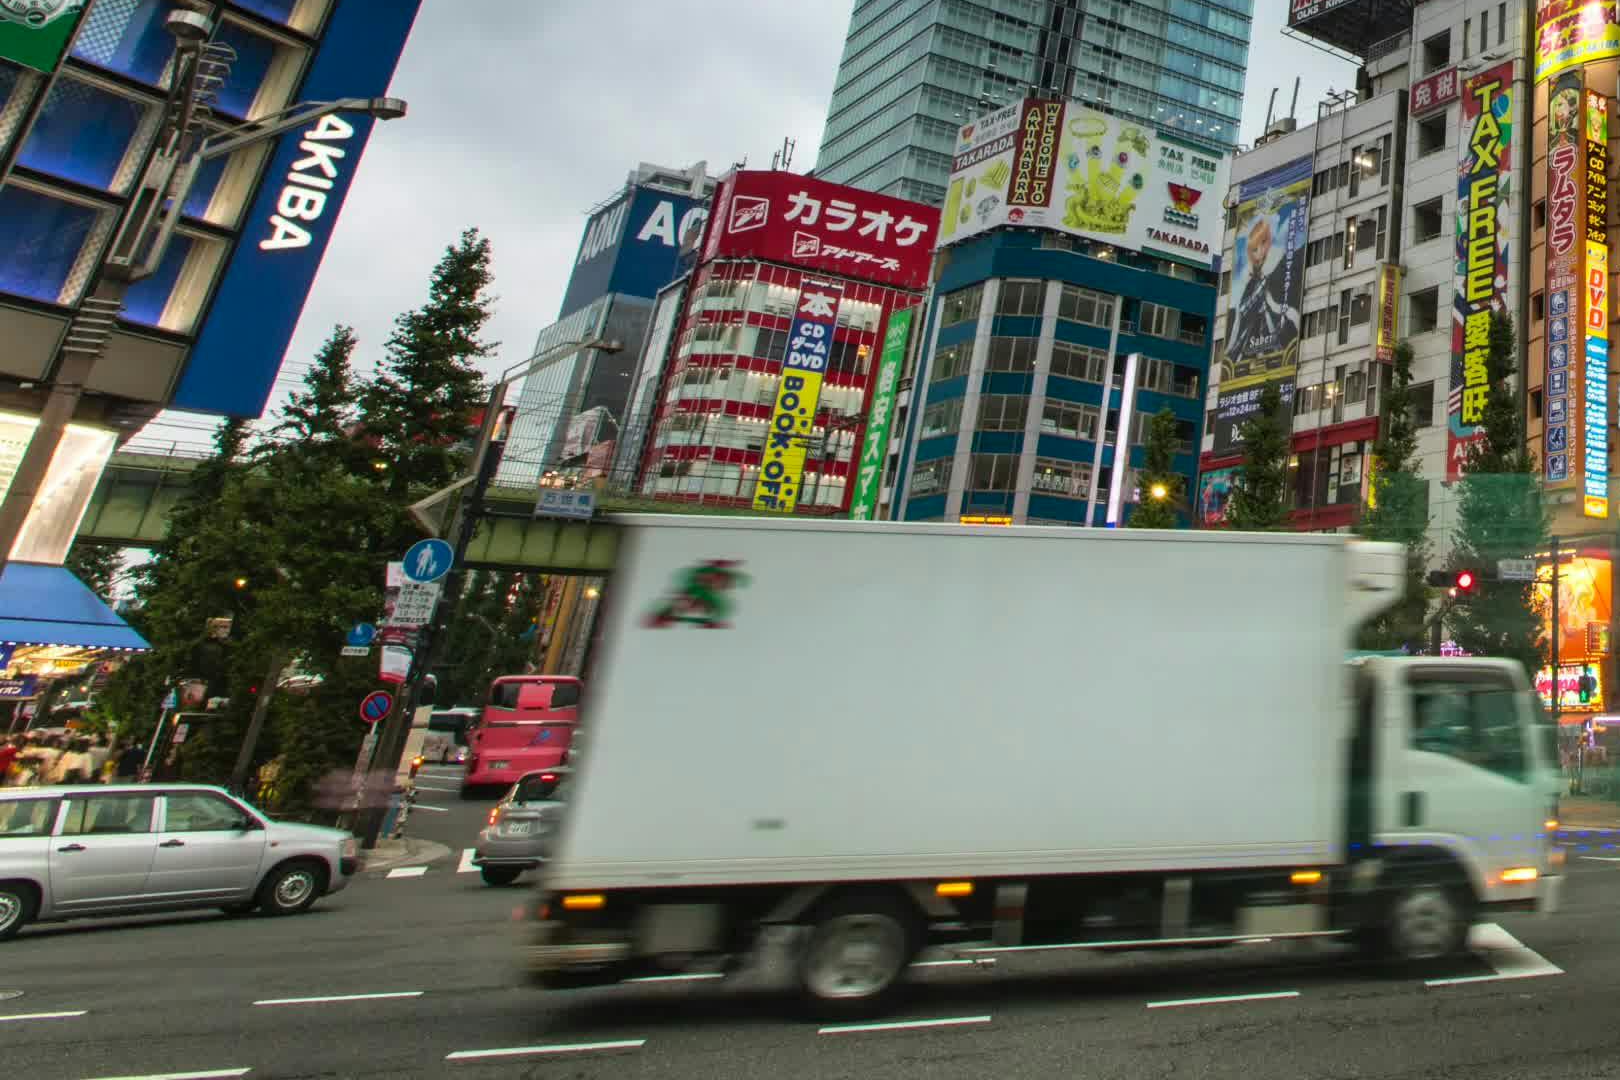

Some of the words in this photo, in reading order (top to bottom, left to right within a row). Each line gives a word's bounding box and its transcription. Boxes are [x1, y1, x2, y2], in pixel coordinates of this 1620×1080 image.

[1414, 72, 1454, 108] 免税
[1037, 104, 1060, 178] WELCOME
[1470, 79, 1501, 176] TAX
[955, 135, 1014, 170] TAKARADA
[1013, 108, 1042, 204] AKIHABARA
[1160, 146, 1184, 162] TAX
[1191, 156, 1217, 173] FREE
[1589, 157, 1604, 171] CD
[259, 113, 354, 251] AKIBA
[1031, 181, 1046, 204] TO
[1549, 145, 1576, 255] ラムタラ
[578, 201, 627, 264] AOKI
[784, 190, 929, 247] カラオケ
[1146, 227, 1210, 255] TAKARADA
[1466, 173, 1498, 304] FREE
[818, 243, 902, 272] アドアーズ
[803, 292, 835, 318] 本
[1589, 268, 1606, 330] DVD
[792, 335, 826, 355] ゲーム
[800, 323, 825, 338] CD
[1249, 335, 1274, 348] Saber
[789, 352, 824, 370] DVD
